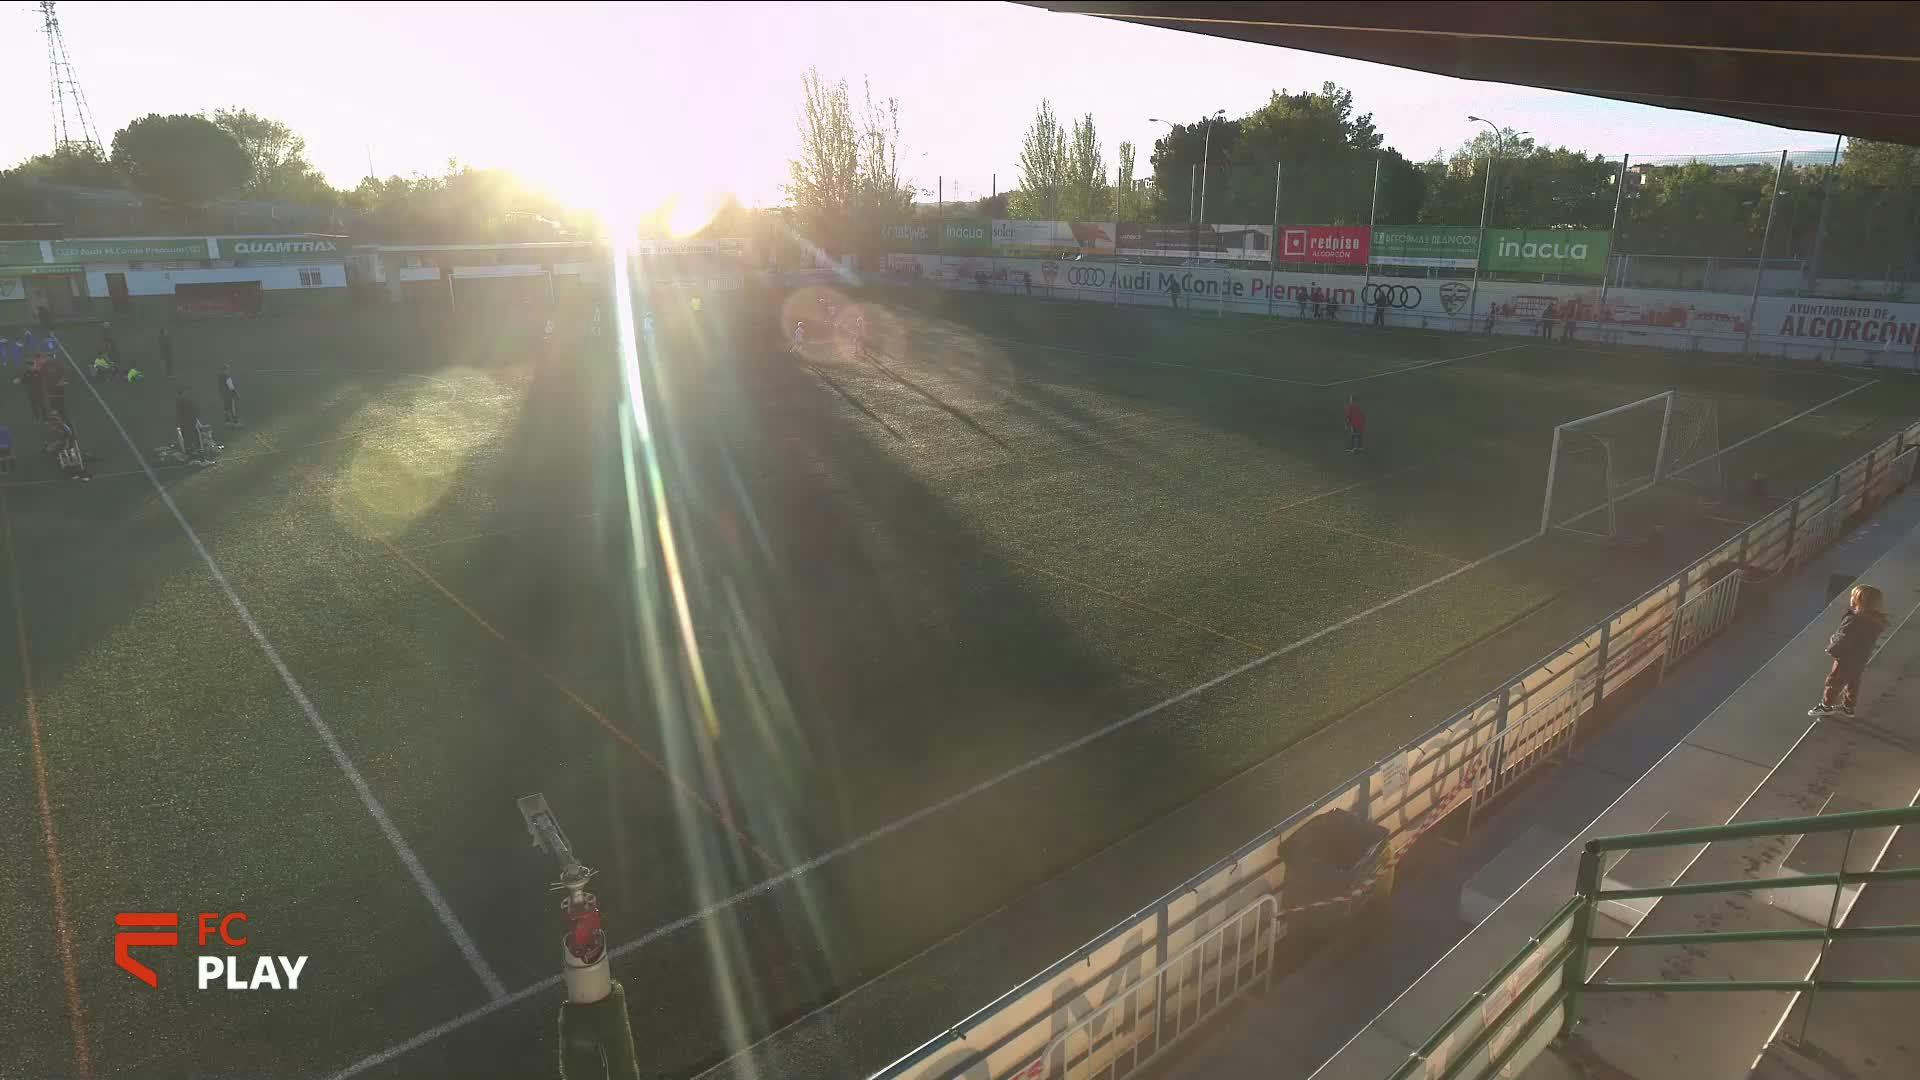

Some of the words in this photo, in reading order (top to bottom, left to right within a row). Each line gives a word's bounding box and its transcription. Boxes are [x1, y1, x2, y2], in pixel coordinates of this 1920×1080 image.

[234, 240, 337, 254] QUAMTRAX
[1310, 236, 1360, 251] redpiso
[1497, 236, 1588, 261] inacua
[1109, 270, 1151, 291] Audi
[1250, 278, 1355, 305] Premium
[1789, 303, 1871, 318] AYUNTAMIENTO
[1873, 307, 1889, 320] DE
[1780, 315, 1917, 345] ALCORCÓN
